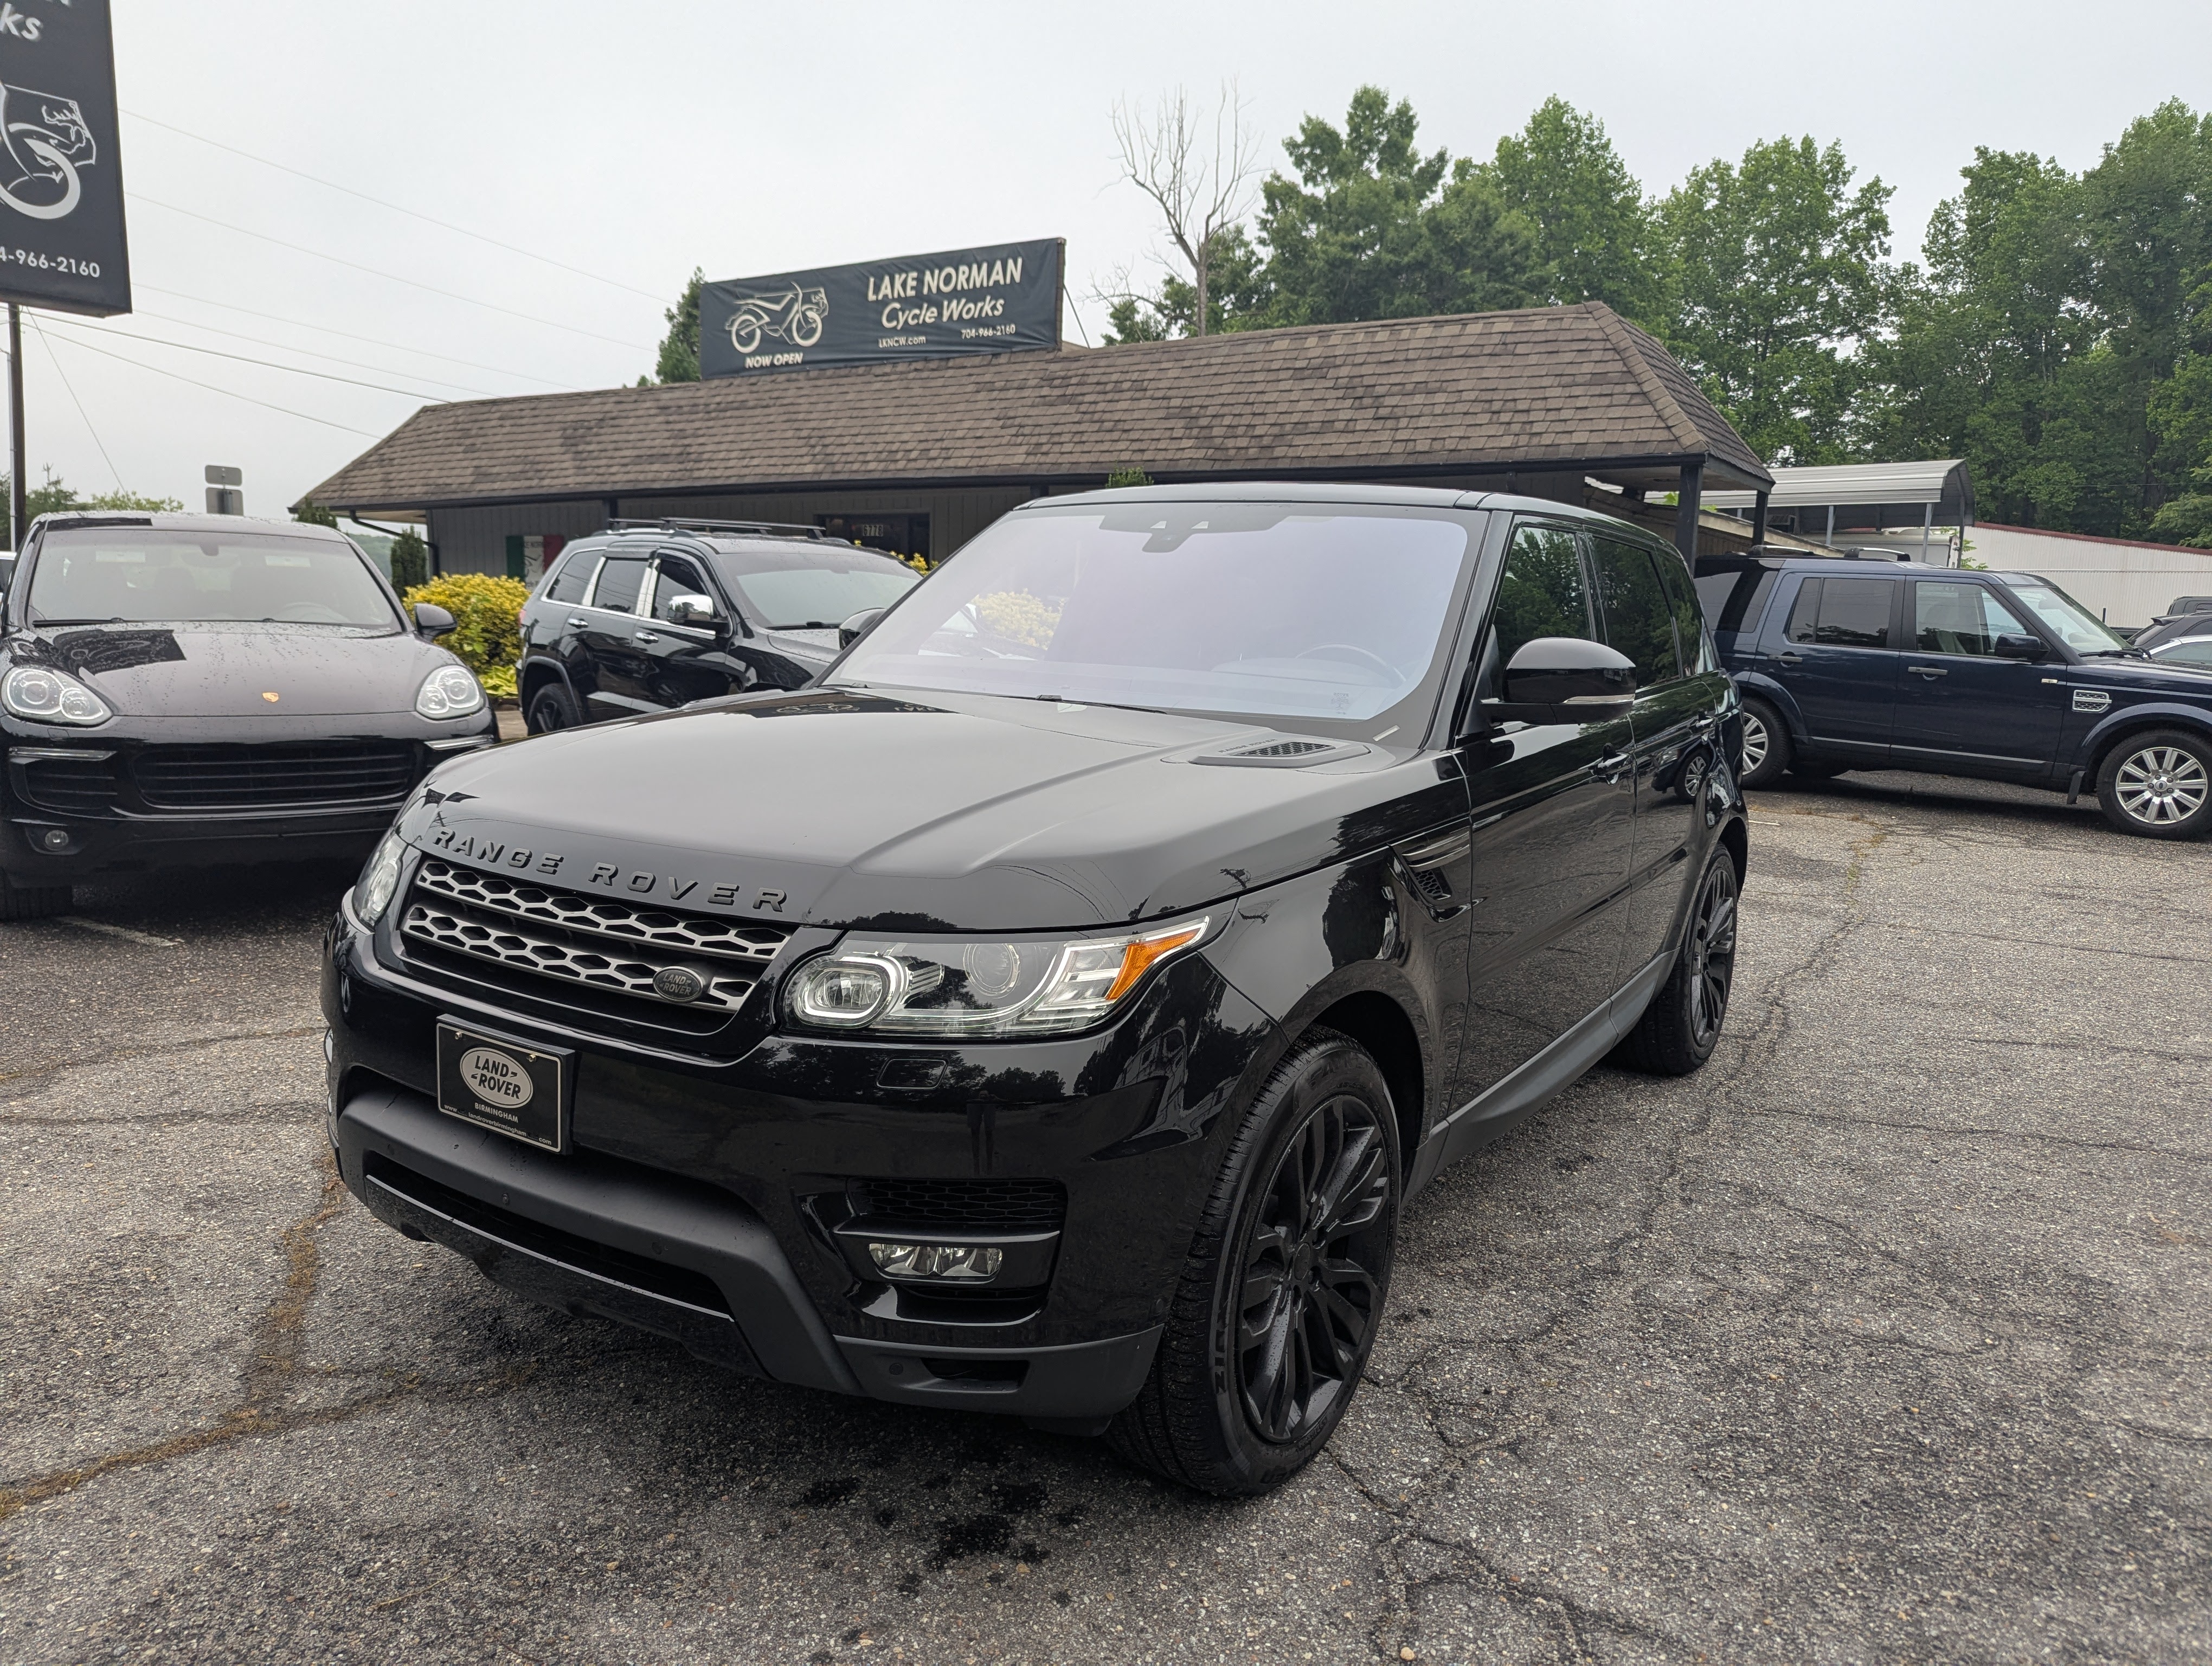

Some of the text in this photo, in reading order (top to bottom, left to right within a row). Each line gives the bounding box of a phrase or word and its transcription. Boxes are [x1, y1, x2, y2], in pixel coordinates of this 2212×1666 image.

[867, 256, 1023, 302] LAKE NORMAN
[881, 294, 1005, 330] Cycle Works
[878, 335, 927, 348] LKNCW.com
[961, 323, 1016, 339] 704-966-2160
[745, 352, 803, 369] NOW OPEN
[432, 826, 787, 912] RANGE ROVER
[663, 973, 686, 985] LAND
[663, 982, 692, 996] ROVER
[474, 1055, 509, 1078] LAND
[478, 1073, 521, 1100] ROVER
[474, 1102, 518, 1123] BIRMINGHAM
[468, 1112, 527, 1137] landroverbirmingham
[538, 1137, 552, 1145] com
